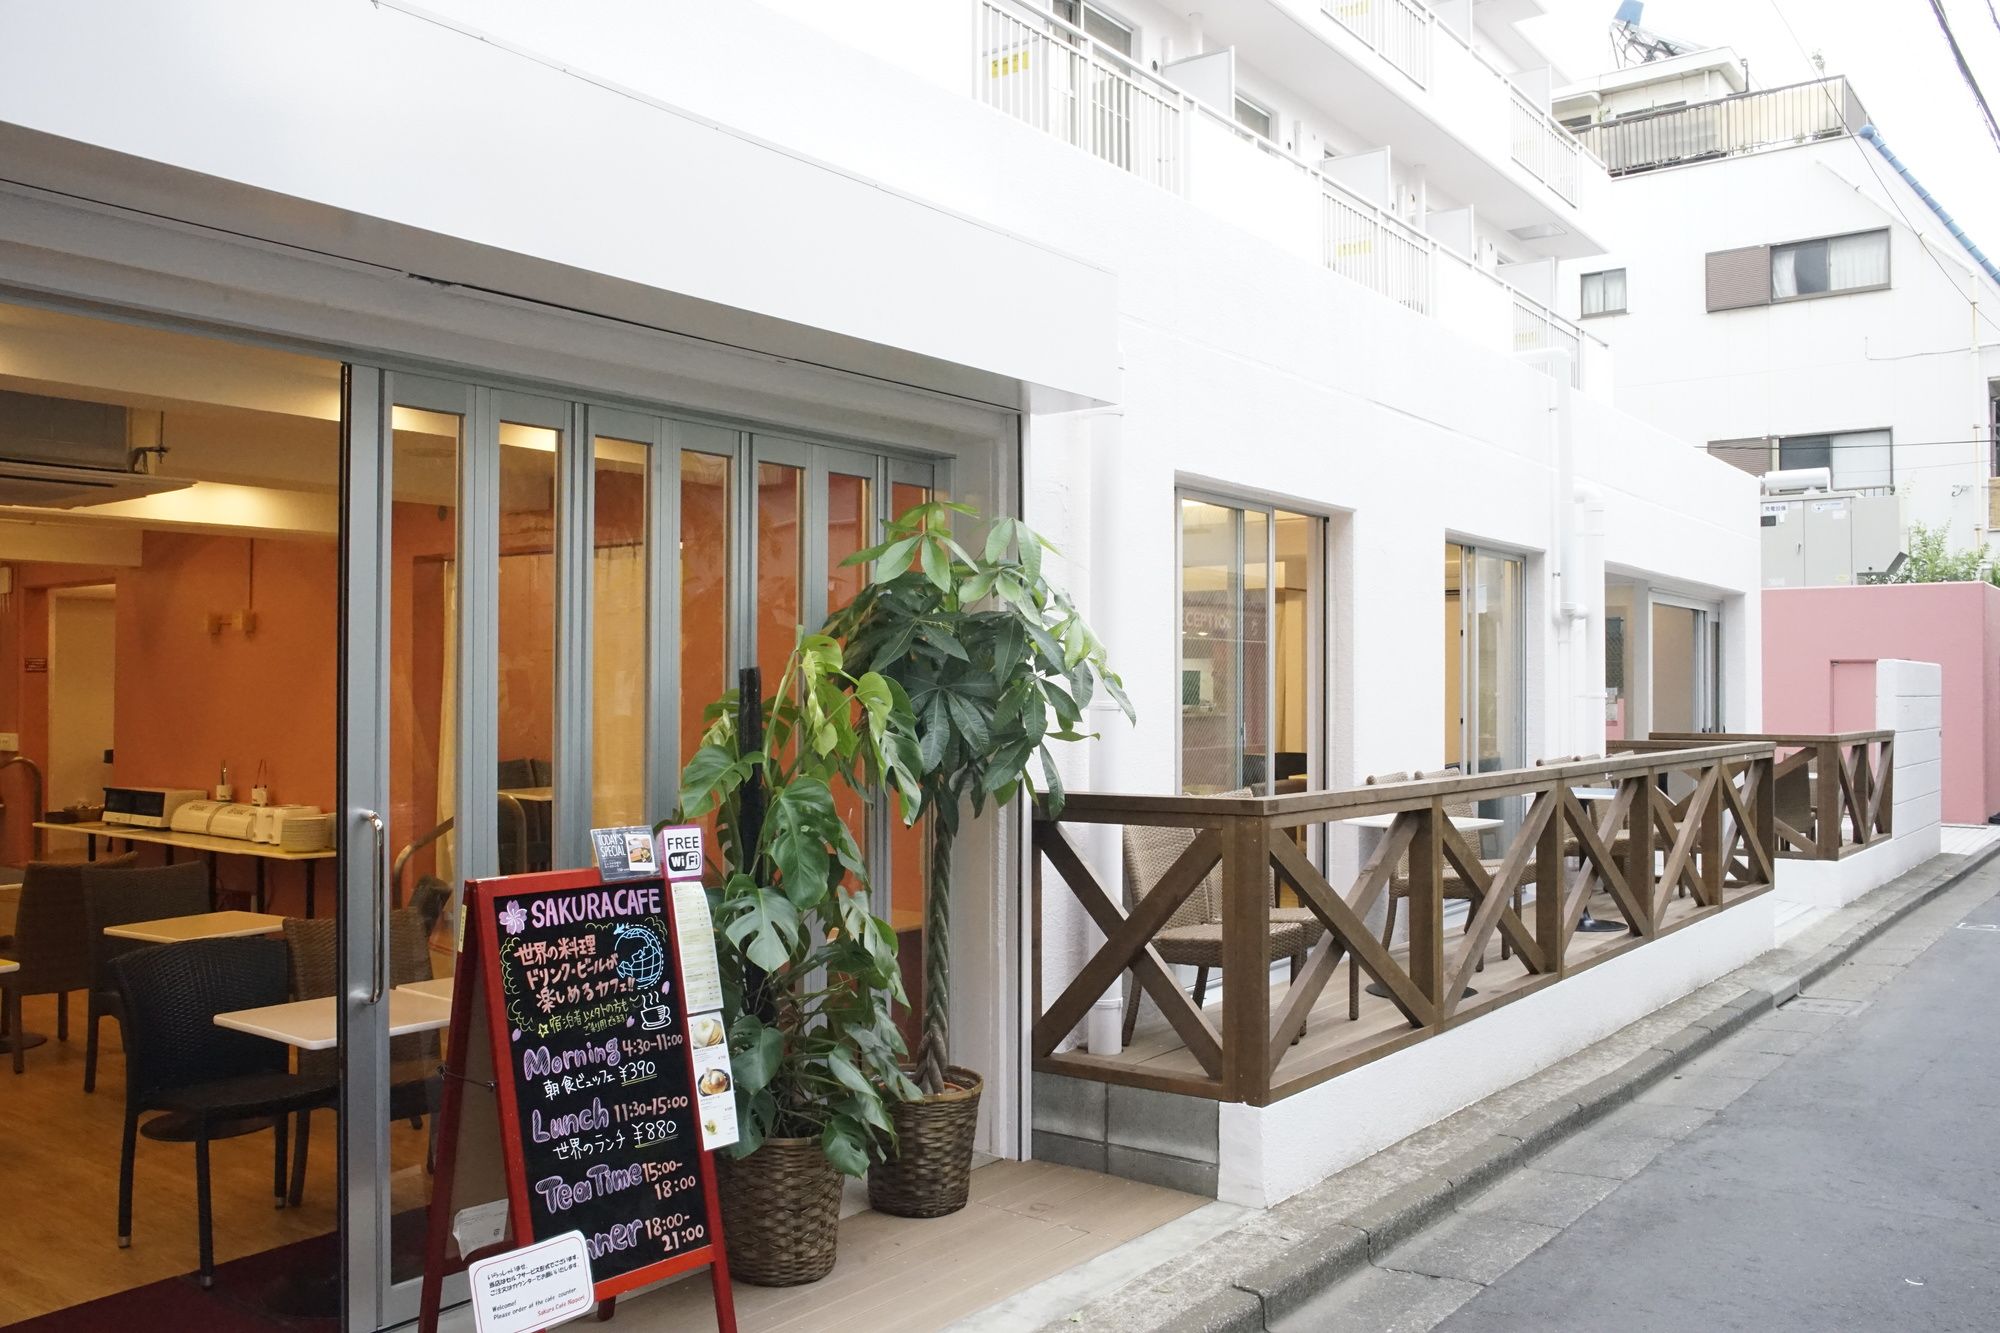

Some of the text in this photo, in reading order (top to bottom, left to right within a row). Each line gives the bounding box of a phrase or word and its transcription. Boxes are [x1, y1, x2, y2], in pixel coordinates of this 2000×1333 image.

[597, 832, 624, 847] TODAY'S
[600, 845, 627, 859] SPECIAL
[667, 836, 700, 851] FREE
[514, 934, 597, 966] 世界の料理
[523, 1037, 621, 1081] Morning
[543, 1060, 656, 1101] 朝食ビュッフェ ¥390
[532, 1097, 610, 1144] Lunch
[552, 1120, 677, 1160] 世界のランチ ¥880
[654, 1175, 697, 1200] 18:00
[586, 1219, 644, 1260] nner
[661, 1224, 705, 1252] 21:00
[492, 1300, 517, 1312] Welcome!
[493, 1309, 511, 1320] Please
[512, 1305, 528, 1315] order
[558, 1287, 577, 1298] counter
[538, 1295, 585, 1316] Sakura Cafe Nippori
